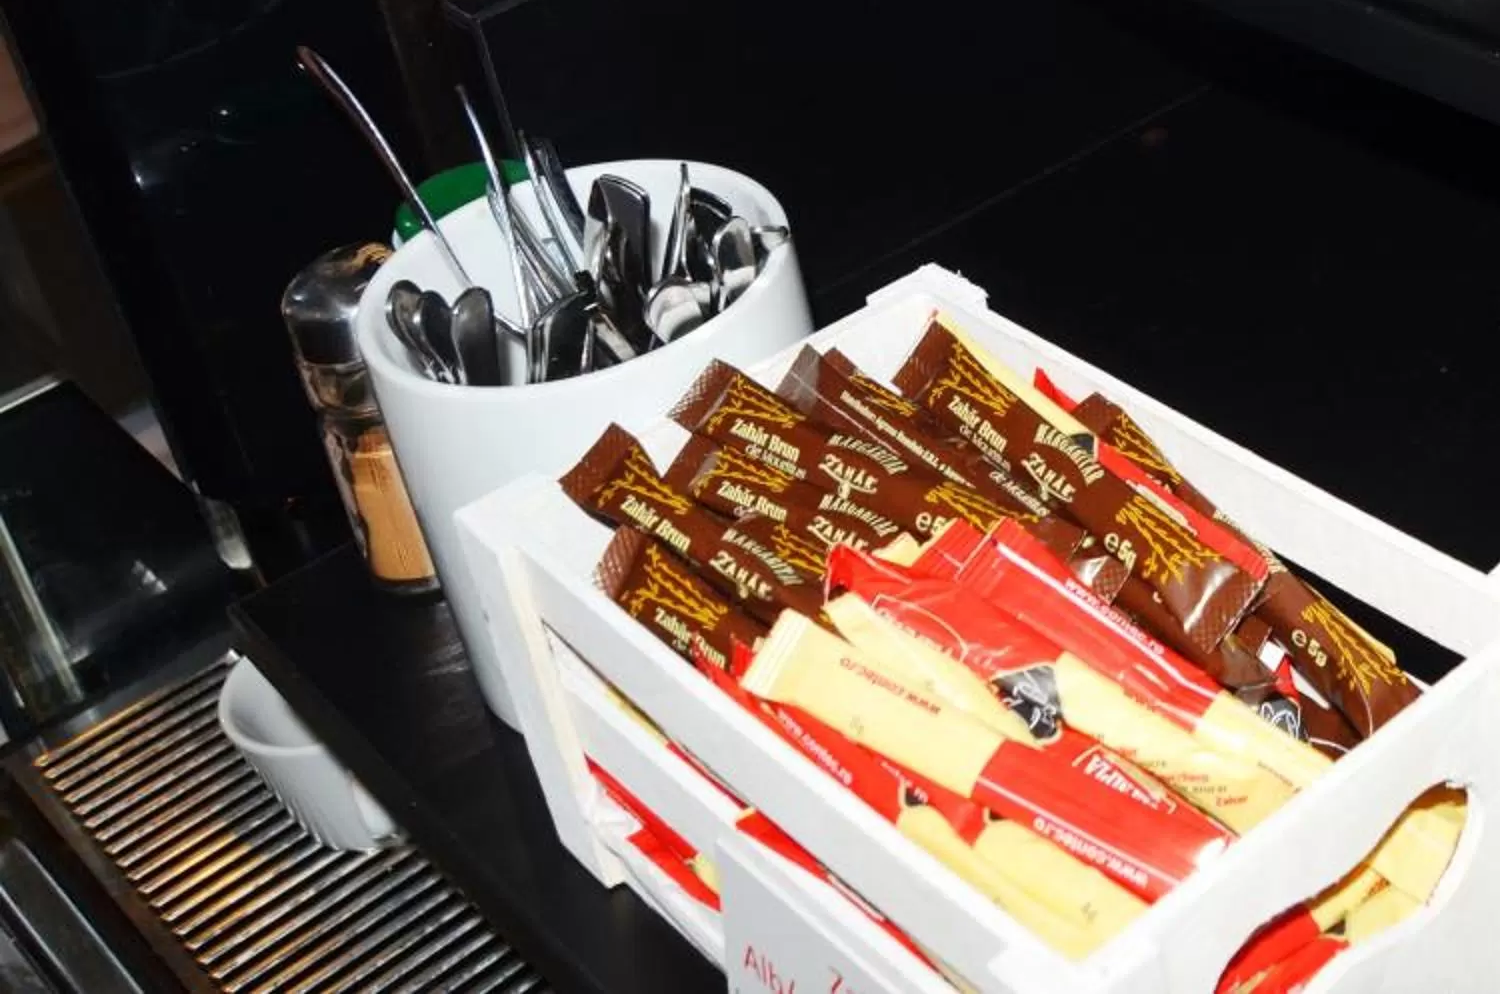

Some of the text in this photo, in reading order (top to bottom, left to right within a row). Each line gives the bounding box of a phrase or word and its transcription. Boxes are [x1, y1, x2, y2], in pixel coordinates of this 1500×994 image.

[767, 434, 801, 464] Brun
[977, 419, 1009, 454] Brun
[755, 495, 788, 523] Brun
[655, 518, 692, 553] Brun
[1308, 638, 1328, 667] 5g
